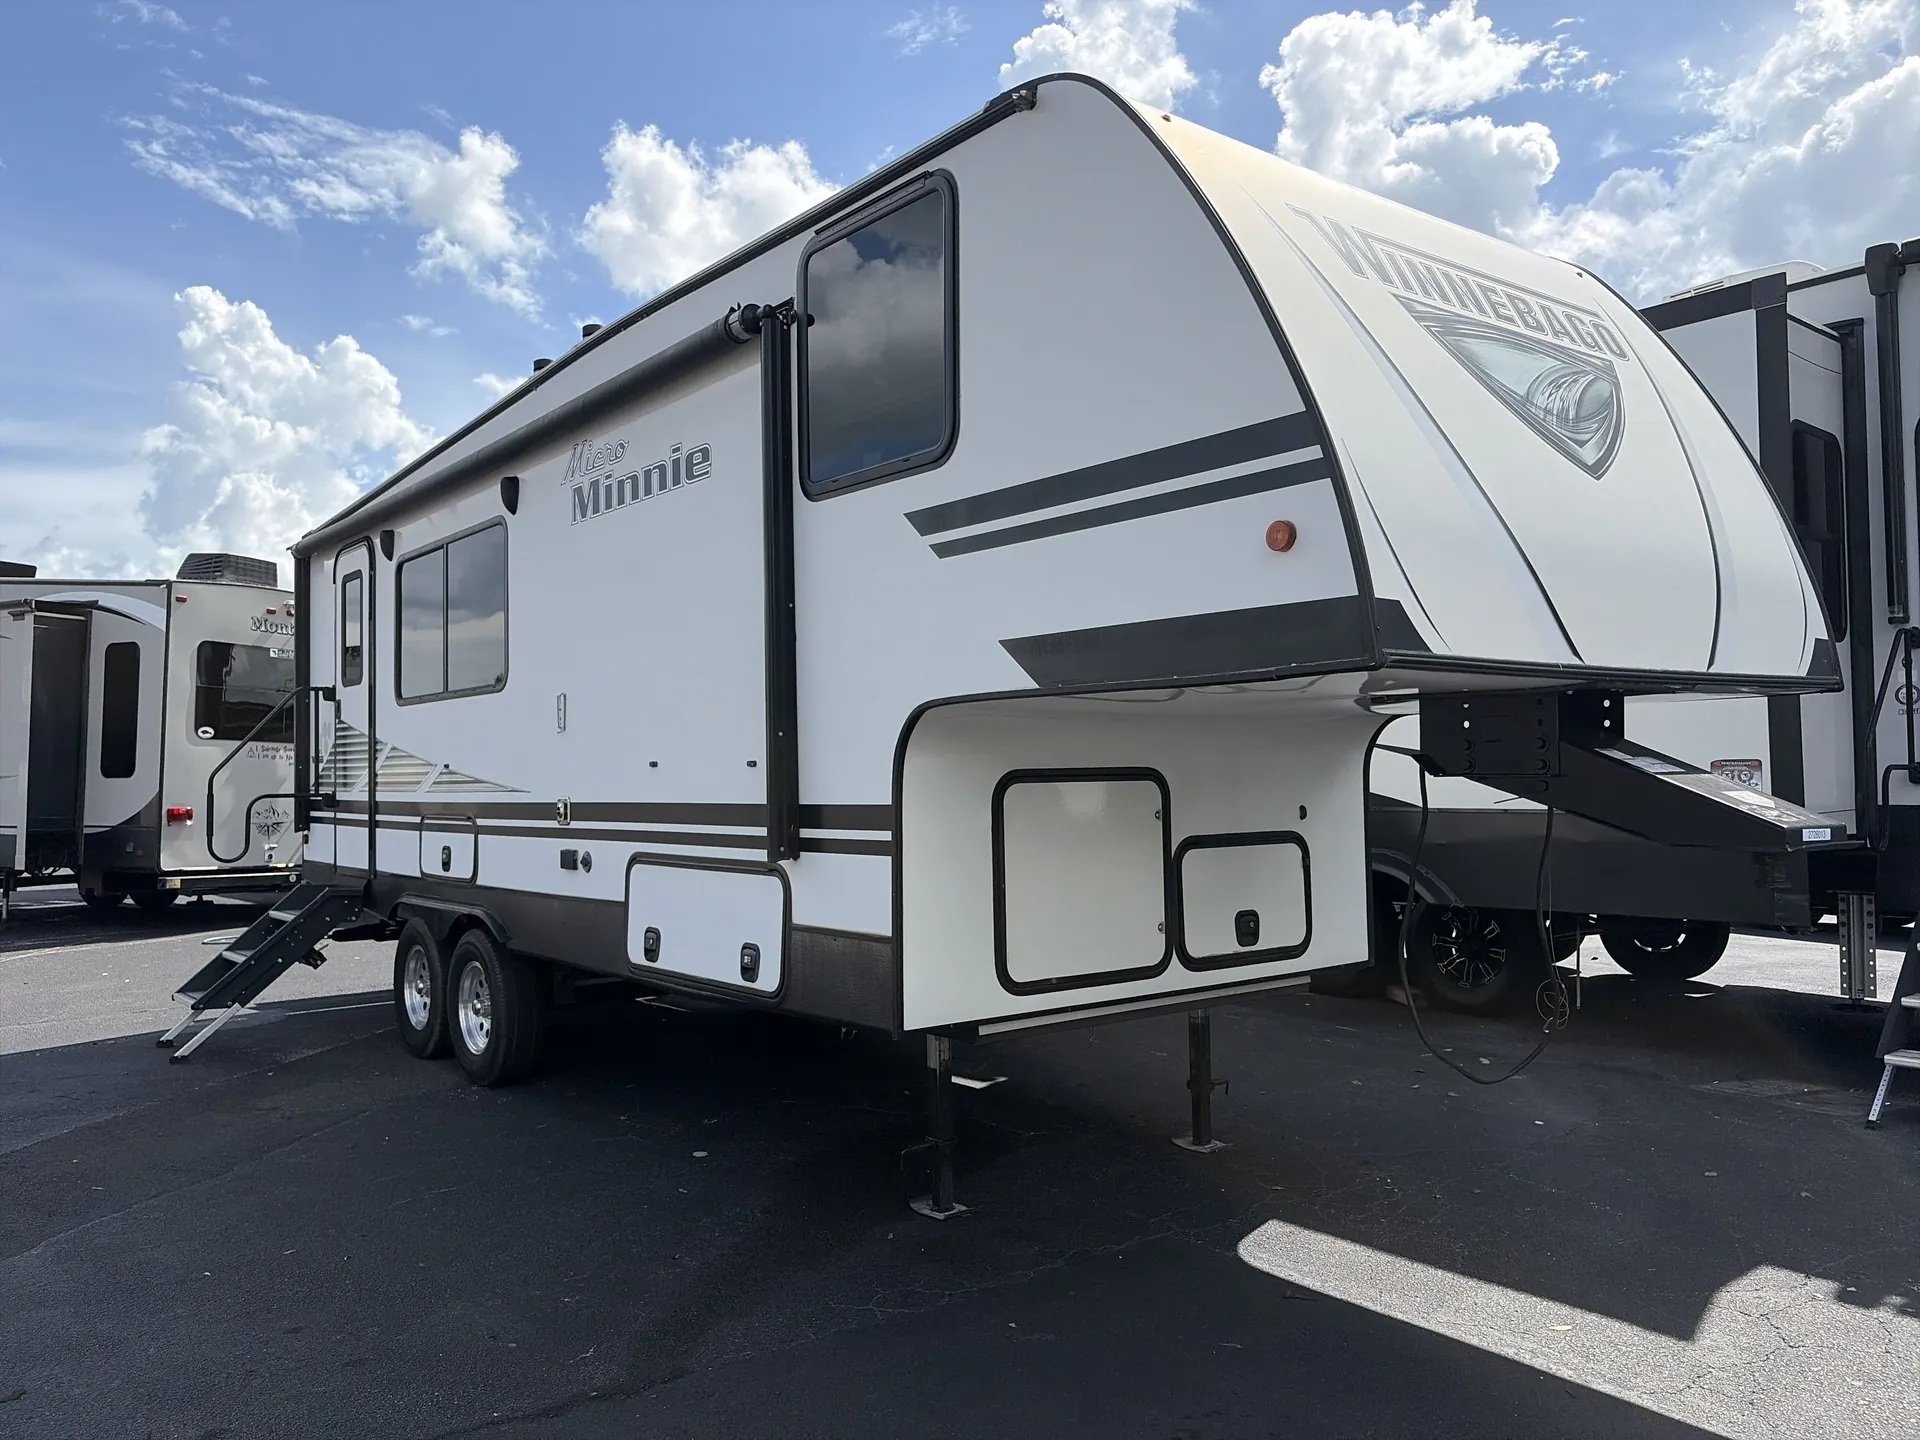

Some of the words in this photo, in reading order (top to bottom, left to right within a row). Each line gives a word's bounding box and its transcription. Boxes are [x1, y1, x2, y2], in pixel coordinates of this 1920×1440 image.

[1284, 203, 1629, 361] WINNEBAGO
[561, 438, 630, 485] Micro
[571, 442, 712, 526] Minnie
